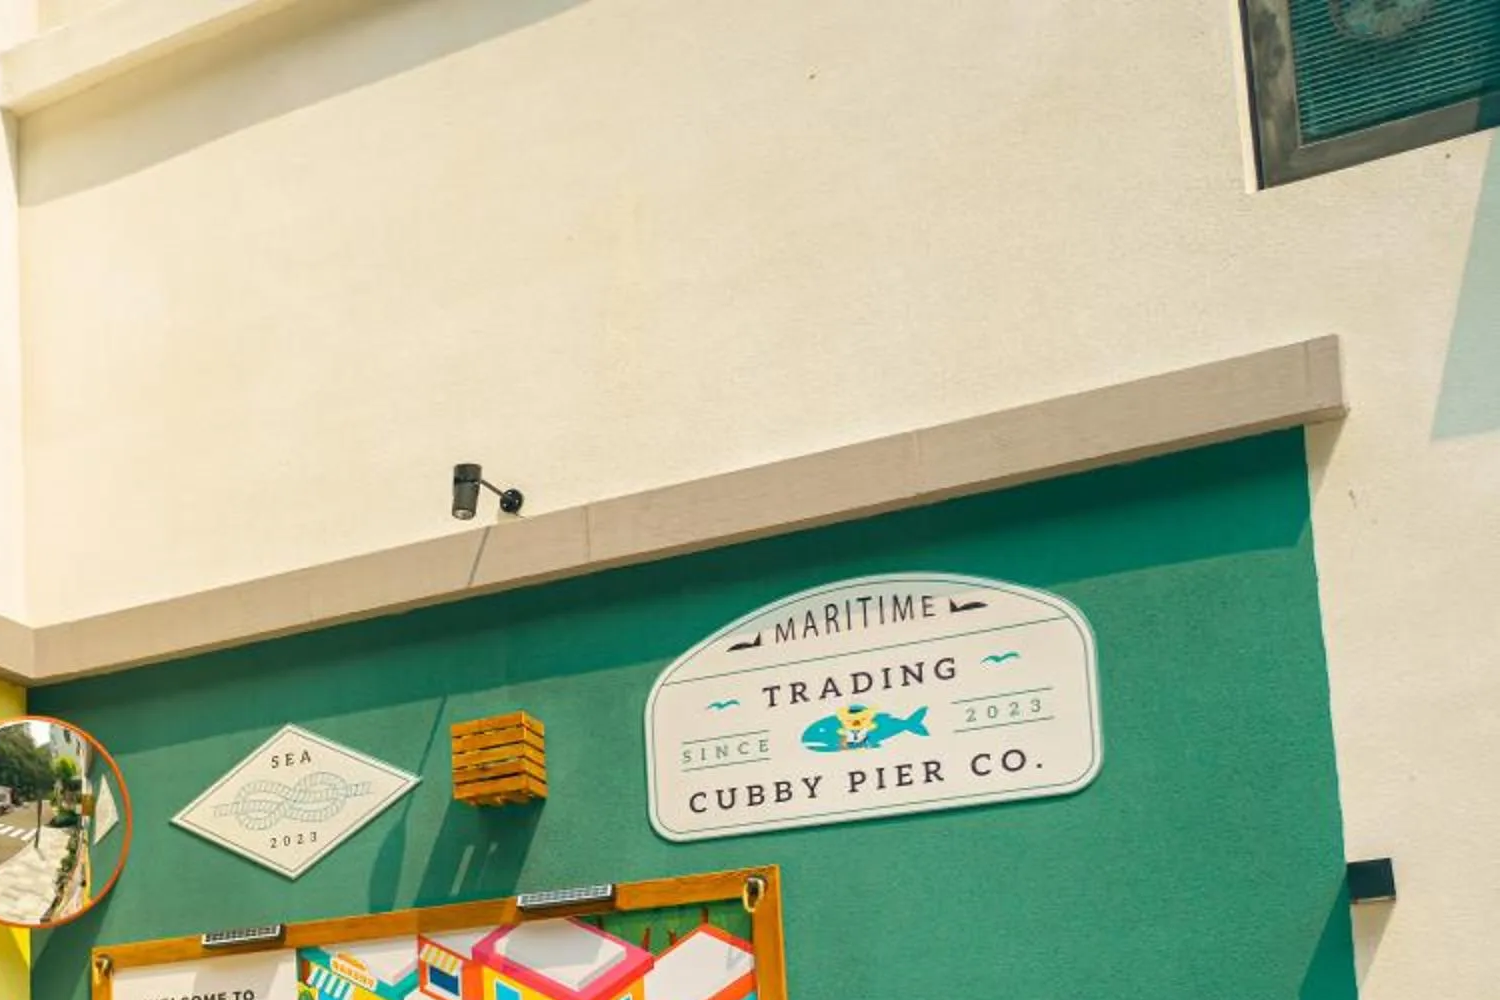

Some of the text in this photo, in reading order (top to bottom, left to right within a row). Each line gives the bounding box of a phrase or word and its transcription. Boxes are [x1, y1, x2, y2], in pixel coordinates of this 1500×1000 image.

[773, 594, 936, 644] MARITIME
[762, 656, 959, 708] TRADING
[964, 698, 1043, 723] 2023
[271, 750, 312, 769] SEA
[682, 737, 770, 764] SINCE
[689, 748, 1044, 814] CUBBY PIER CO.
[270, 831, 318, 849] 2023
